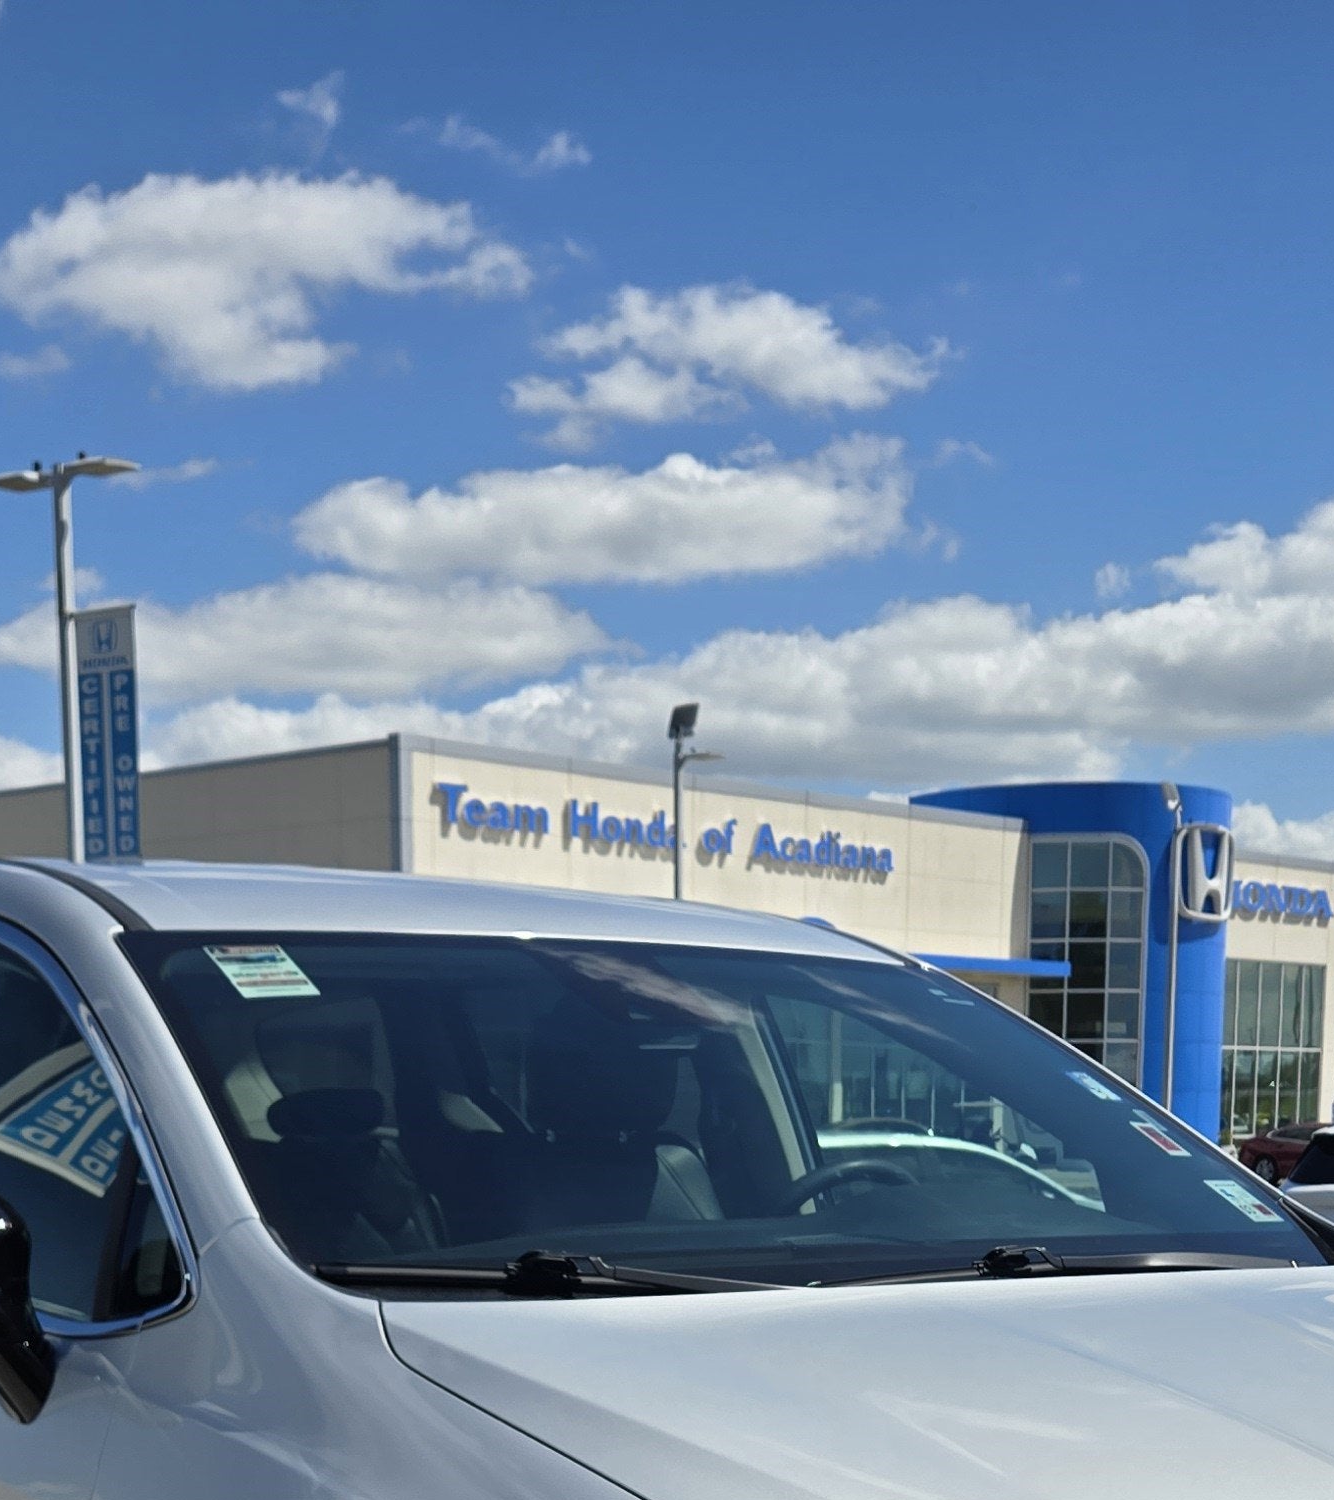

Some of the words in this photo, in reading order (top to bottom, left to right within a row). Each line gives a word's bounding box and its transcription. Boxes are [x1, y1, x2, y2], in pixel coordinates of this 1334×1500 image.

[113, 673, 131, 733] PRE
[81, 677, 105, 854] CERTIFIED
[116, 754, 135, 852] OWNED
[437, 782, 549, 834] Team
[702, 817, 738, 854] of
[751, 823, 894, 872] Acadiana
